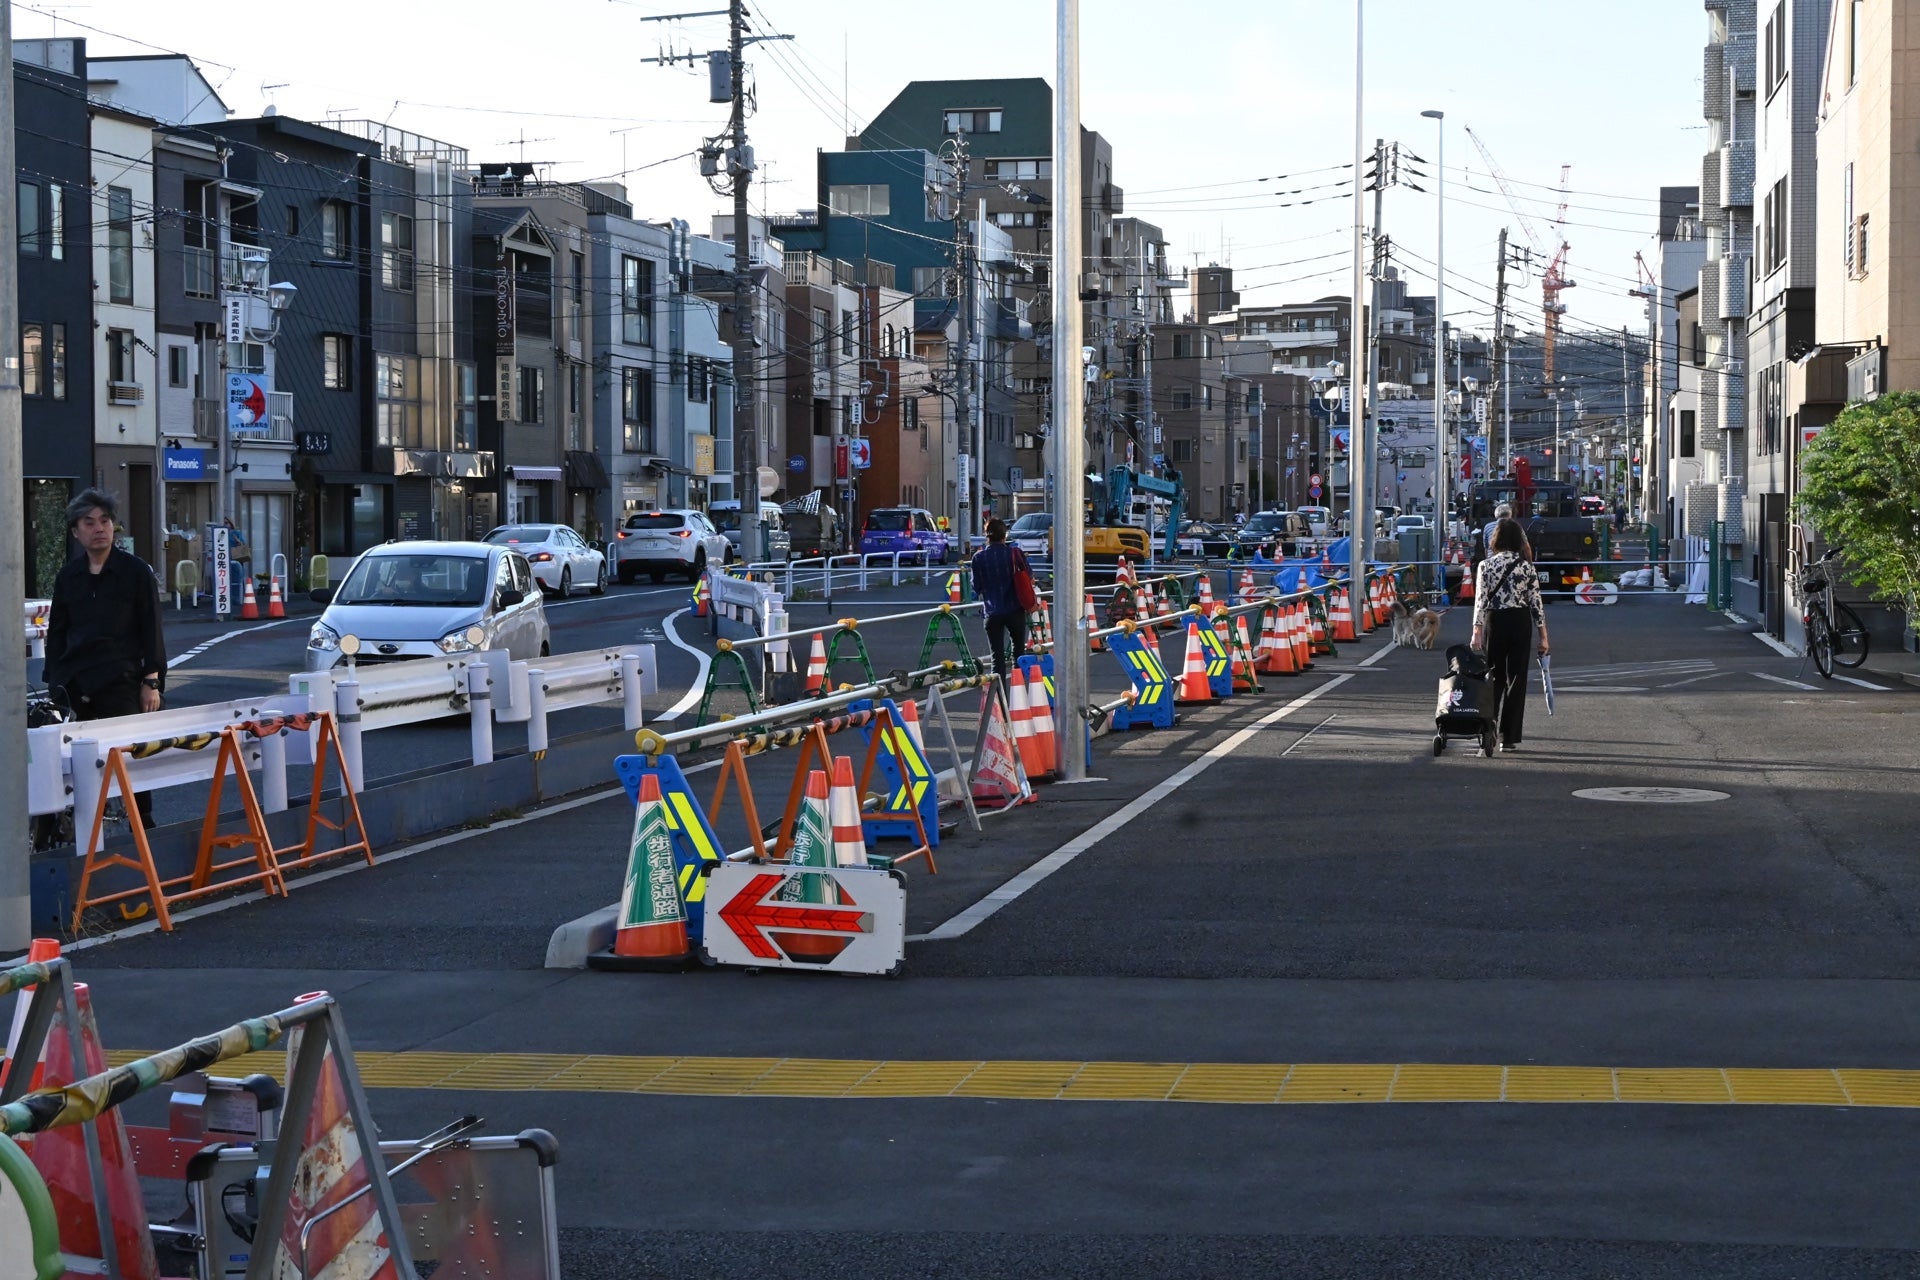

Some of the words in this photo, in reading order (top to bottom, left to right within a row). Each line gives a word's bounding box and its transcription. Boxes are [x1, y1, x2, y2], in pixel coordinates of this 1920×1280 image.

[168, 458, 199, 469] Panasonic
[217, 544, 227, 611] この先カーブあり
[648, 834, 679, 917] 歩行者通路
